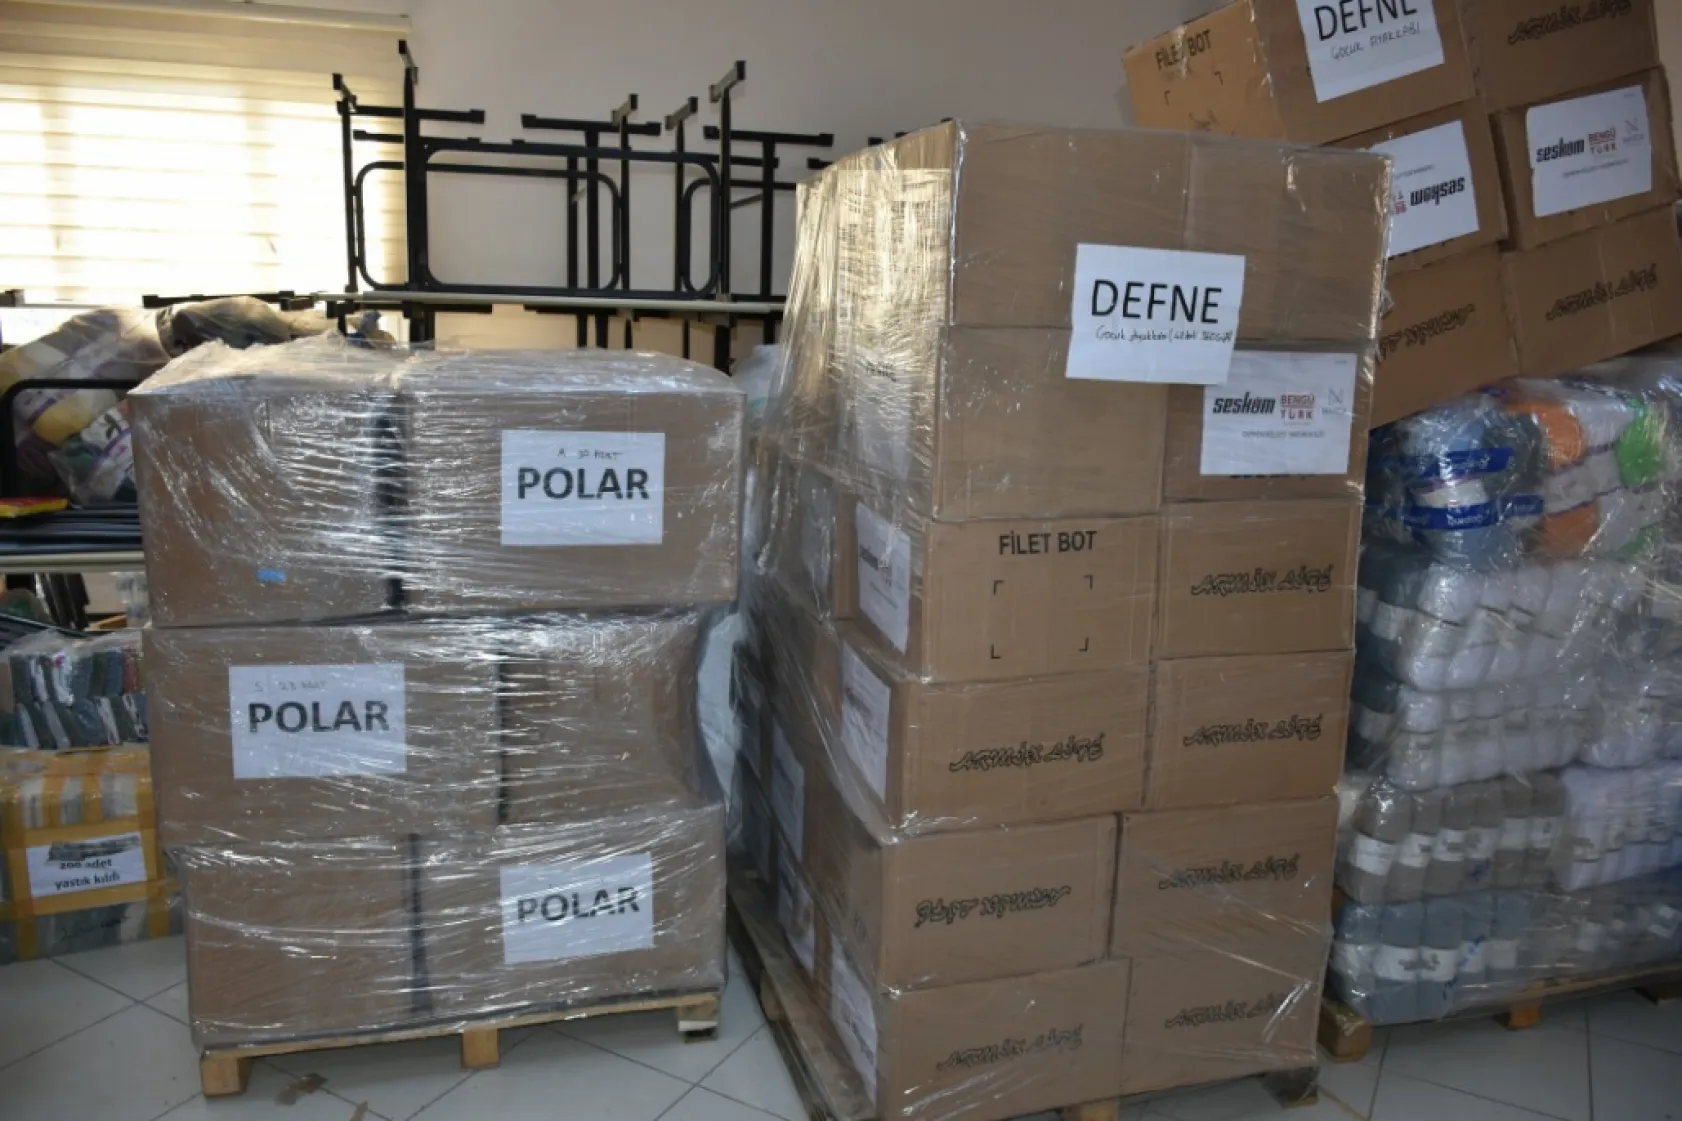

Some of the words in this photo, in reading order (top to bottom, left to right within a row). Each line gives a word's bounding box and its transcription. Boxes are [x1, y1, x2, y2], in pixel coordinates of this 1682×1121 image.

[1187, 29, 1212, 57] BOT
[1536, 137, 1585, 162] seskom
[1091, 279, 1222, 323] DEFNE
[1213, 391, 1276, 415] seskom
[517, 467, 649, 499] POLAR
[999, 529, 1051, 555] FİLET
[1058, 530, 1098, 553] BOT
[248, 700, 390, 732] POLAR
[518, 886, 640, 921] POLAR
